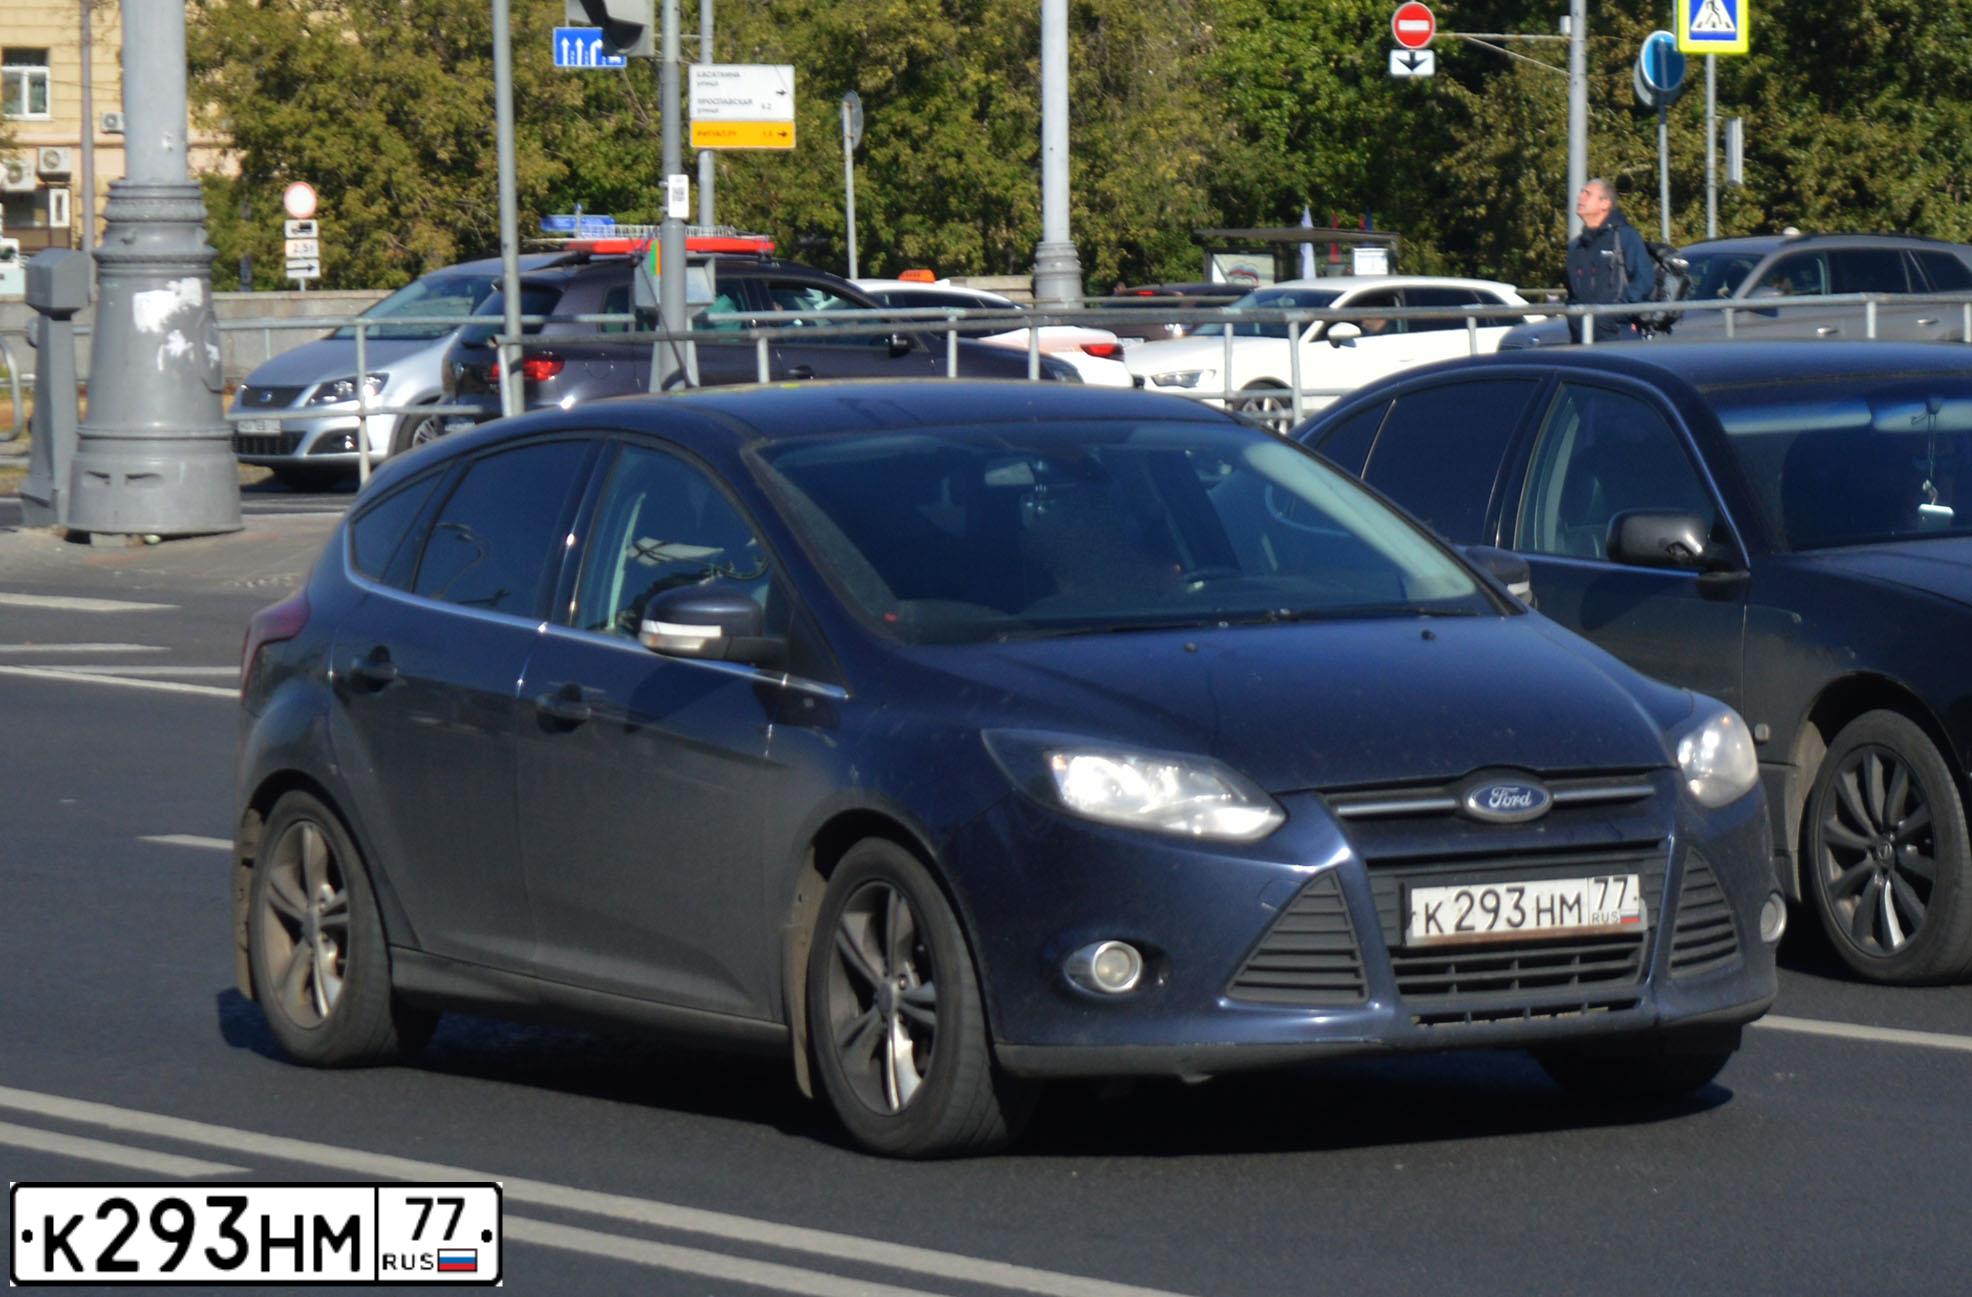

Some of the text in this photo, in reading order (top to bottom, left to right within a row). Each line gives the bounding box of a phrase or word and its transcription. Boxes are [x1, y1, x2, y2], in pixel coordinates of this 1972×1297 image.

[1488, 786, 1533, 808] Ford
[1593, 876, 1629, 910] 77
[1591, 911, 1620, 925] RUS
